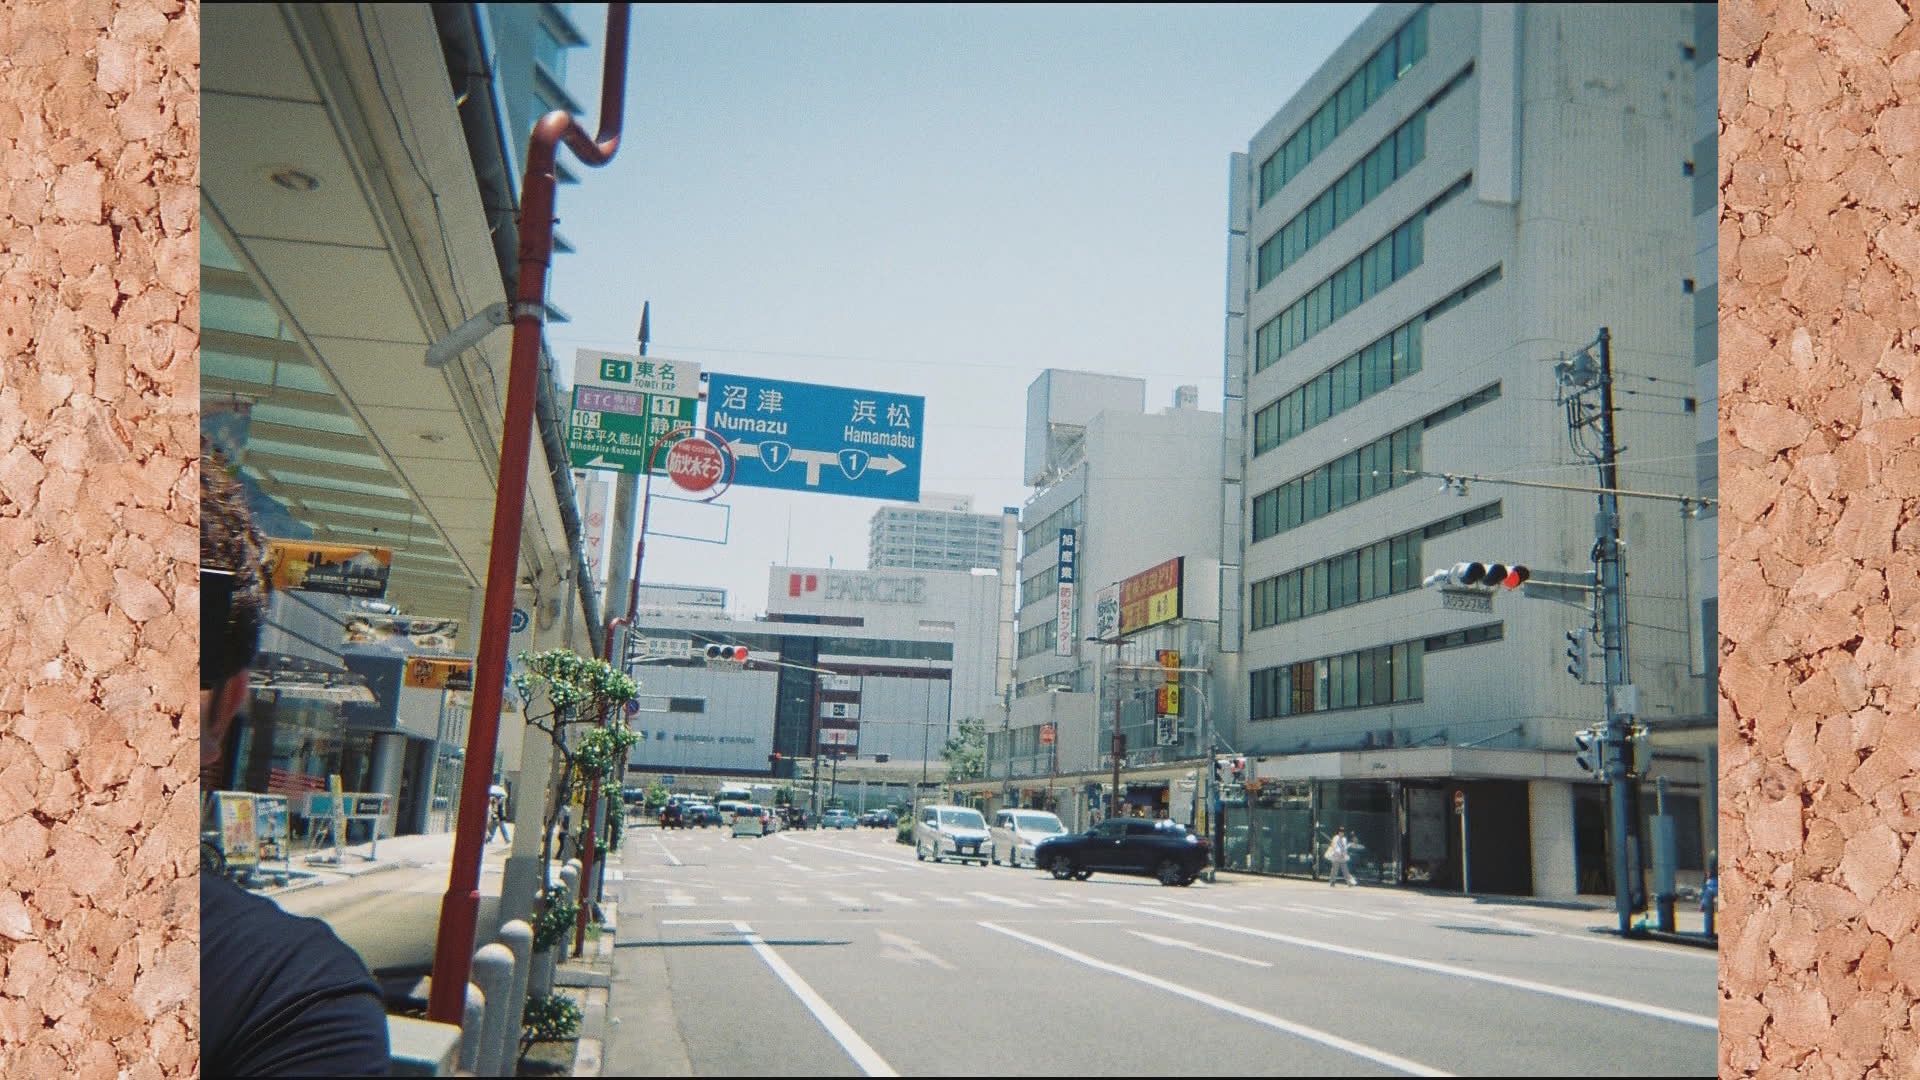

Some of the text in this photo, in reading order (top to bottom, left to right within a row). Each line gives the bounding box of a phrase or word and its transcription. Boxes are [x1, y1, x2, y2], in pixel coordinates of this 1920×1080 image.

[606, 363, 627, 379] E1
[636, 361, 676, 381] 東名
[583, 392, 611, 407] ETC
[655, 399, 676, 415] 11
[723, 384, 784, 413] 沼津
[575, 411, 600, 427] 10-1
[714, 411, 788, 435] Numazu
[851, 400, 911, 429] 浜松
[571, 427, 642, 447] 日本平久能山
[844, 425, 915, 449] Hamamatsu
[771, 446, 779, 464] 1
[849, 454, 858, 471] 1
[669, 452, 721, 479] 防火水そう
[1061, 534, 1073, 579] 旭産業
[824, 576, 927, 603] PARCHE
